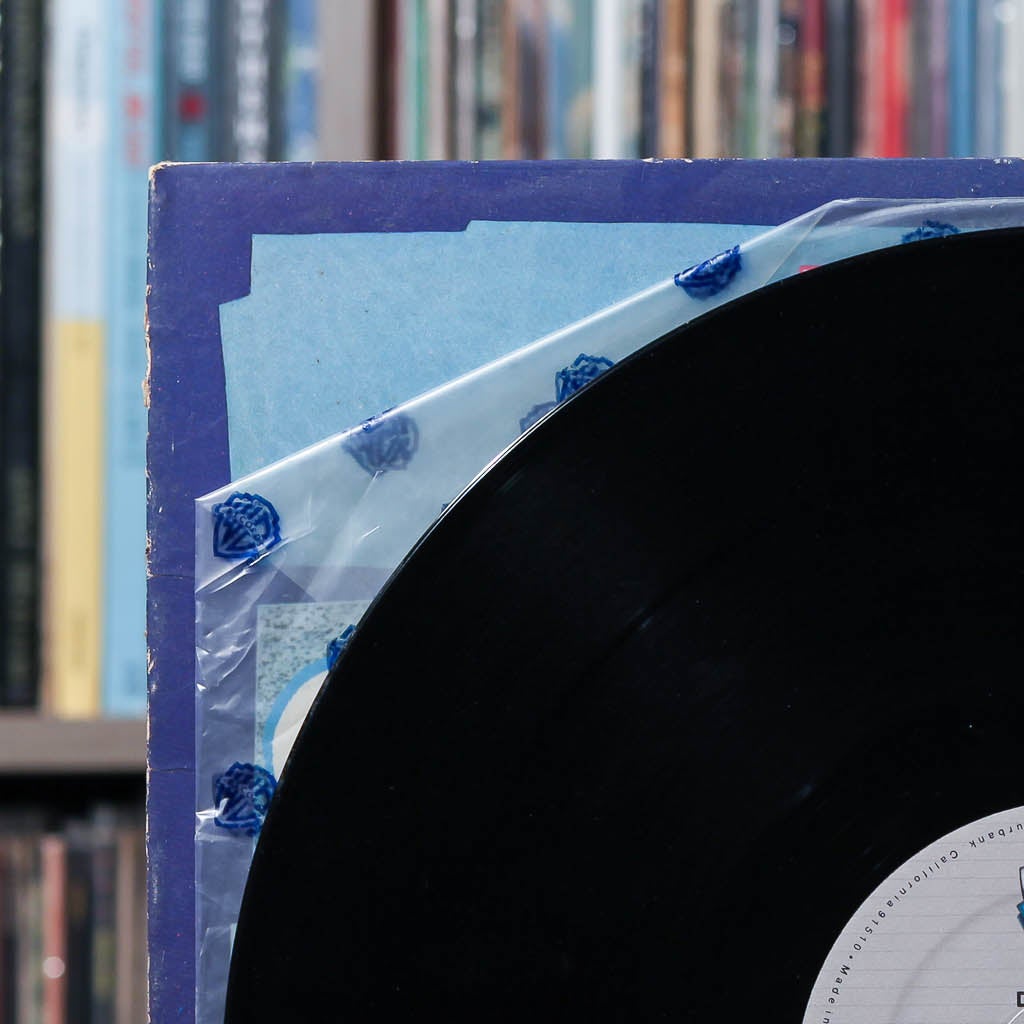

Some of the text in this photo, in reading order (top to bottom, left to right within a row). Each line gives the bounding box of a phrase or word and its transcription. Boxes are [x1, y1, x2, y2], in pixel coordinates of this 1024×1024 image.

[886, 849, 959, 908] California
[853, 910, 886, 951] 91510
[827, 964, 851, 1004] Made
[822, 1010, 832, 1024] in
